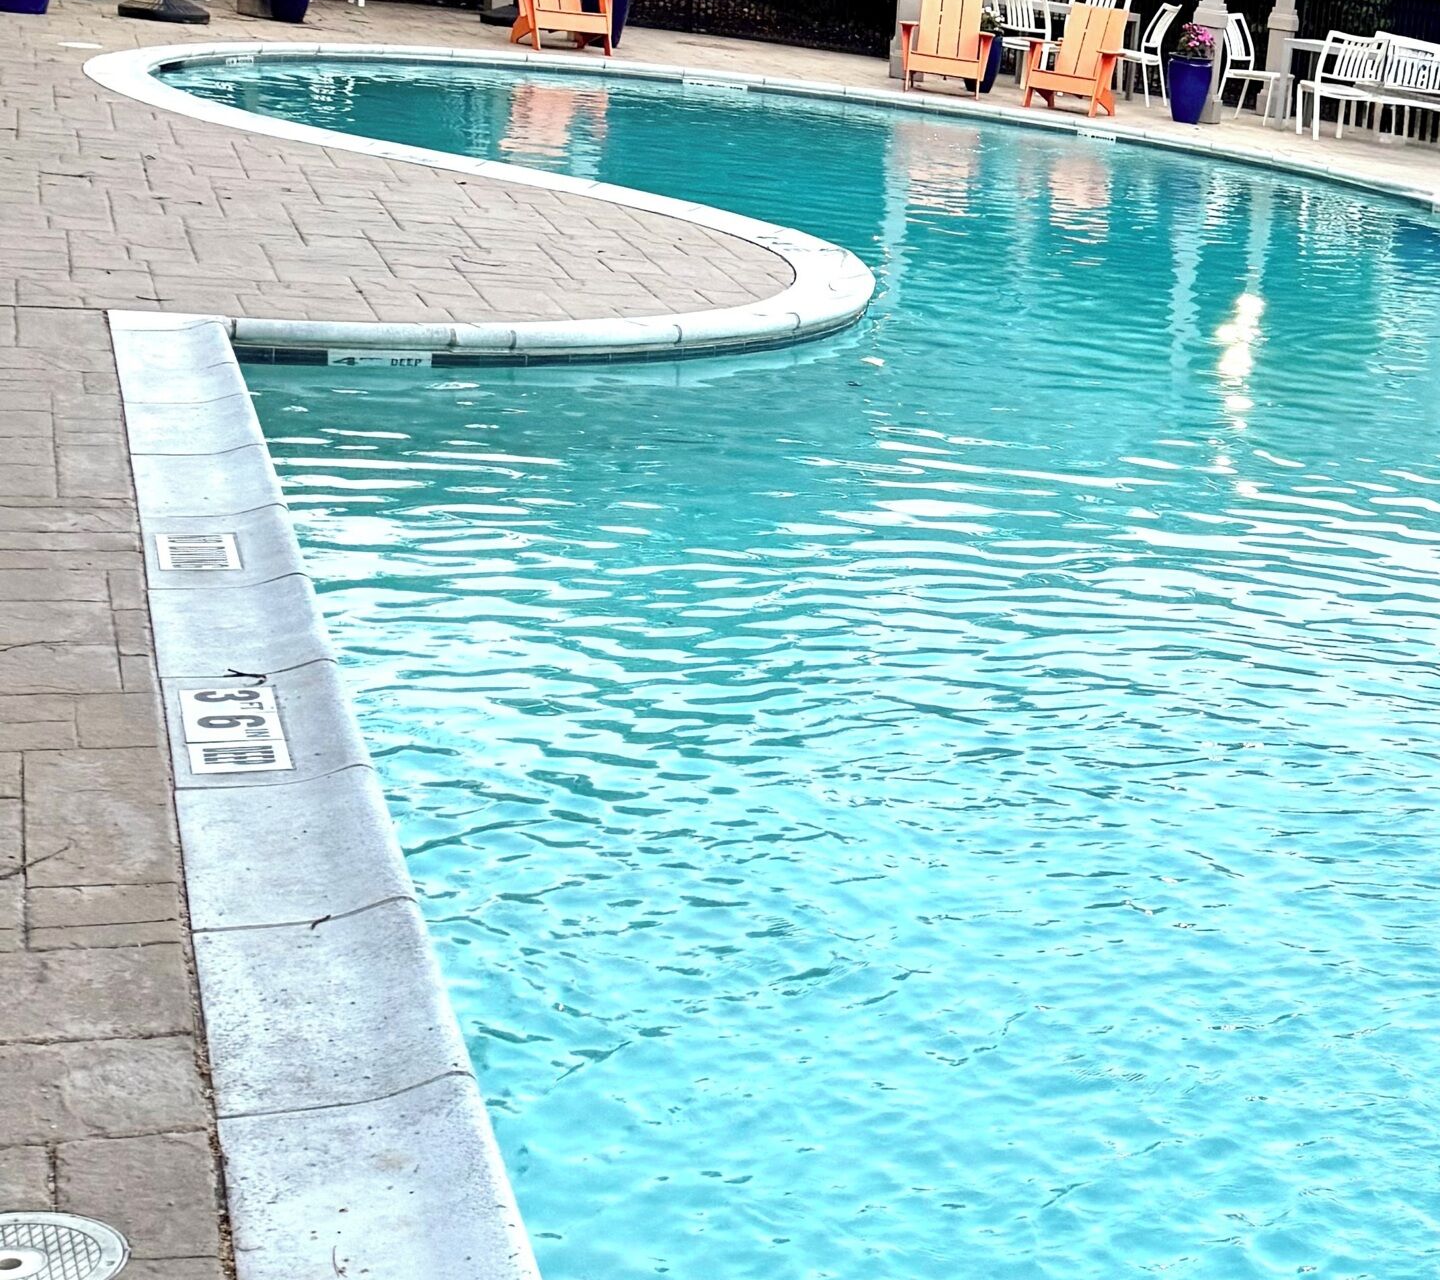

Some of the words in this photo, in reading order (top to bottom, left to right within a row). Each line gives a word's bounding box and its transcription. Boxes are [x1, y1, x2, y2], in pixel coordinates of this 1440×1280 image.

[390, 358, 423, 367] DEEP
[194, 689, 260, 703] 3
[240, 702, 264, 710] FT
[197, 714, 266, 729] 6
[244, 728, 270, 738] IN
[202, 745, 276, 765] DEEP
